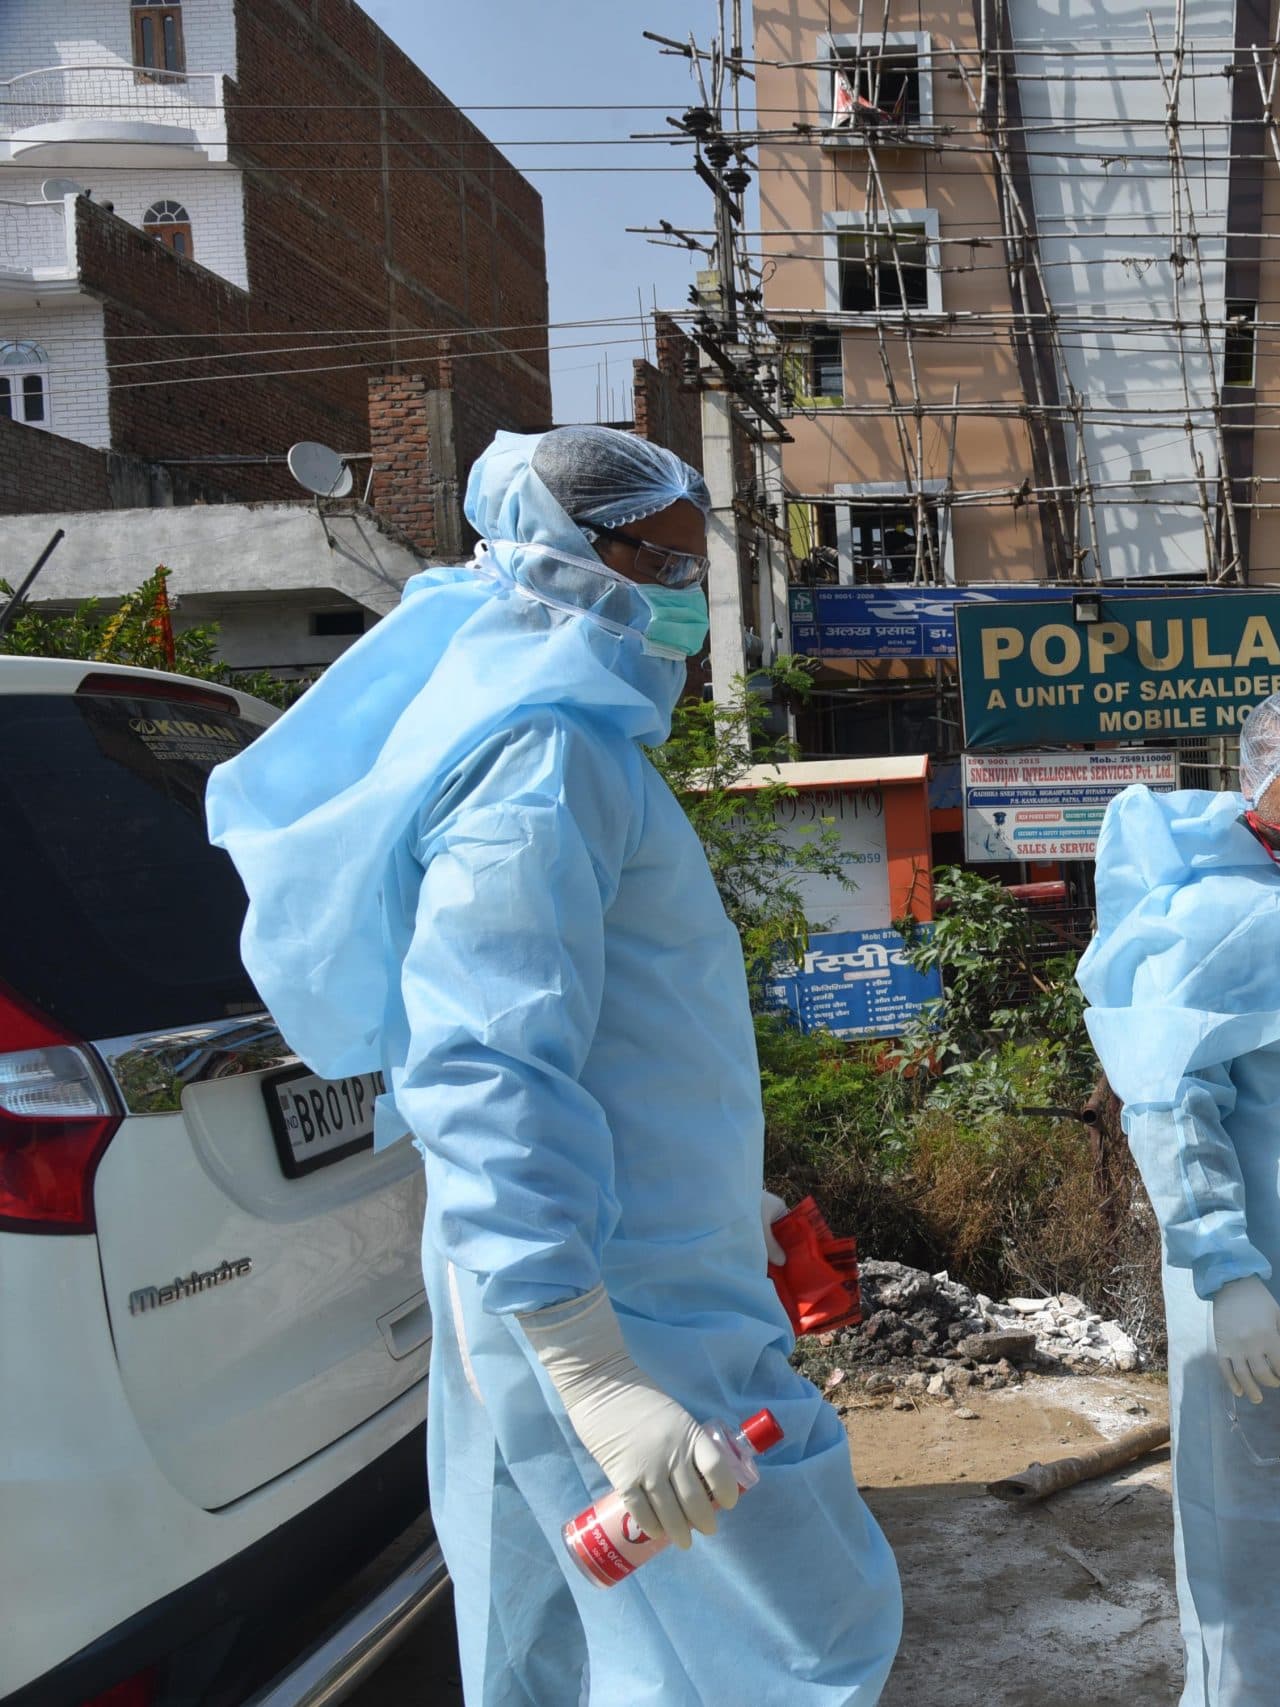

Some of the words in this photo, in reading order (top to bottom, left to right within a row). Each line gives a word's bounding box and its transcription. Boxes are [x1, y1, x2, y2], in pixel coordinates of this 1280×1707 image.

[987, 688, 1007, 710] A
[1015, 684, 1085, 707] UNIT
[1094, 680, 1130, 704] OF
[152, 719, 238, 743] KIRAN
[1099, 707, 1207, 733] MOBILE
[1019, 757, 1040, 765] 2015
[971, 767, 1019, 786] SNEHVIJAY
[1022, 765, 1088, 783] INTELLIGENCE
[1090, 764, 1133, 781] SERVICES
[1136, 763, 1153, 779] Pvt.
[1156, 763, 1174, 778] Ltd.
[1017, 843, 1047, 855] SALES
[1050, 843, 1057, 854] &
[1060, 842, 1096, 854] SERVIC
[130, 1256, 252, 1317] Mahindra
[591, 1527, 609, 1553] 99.9%
